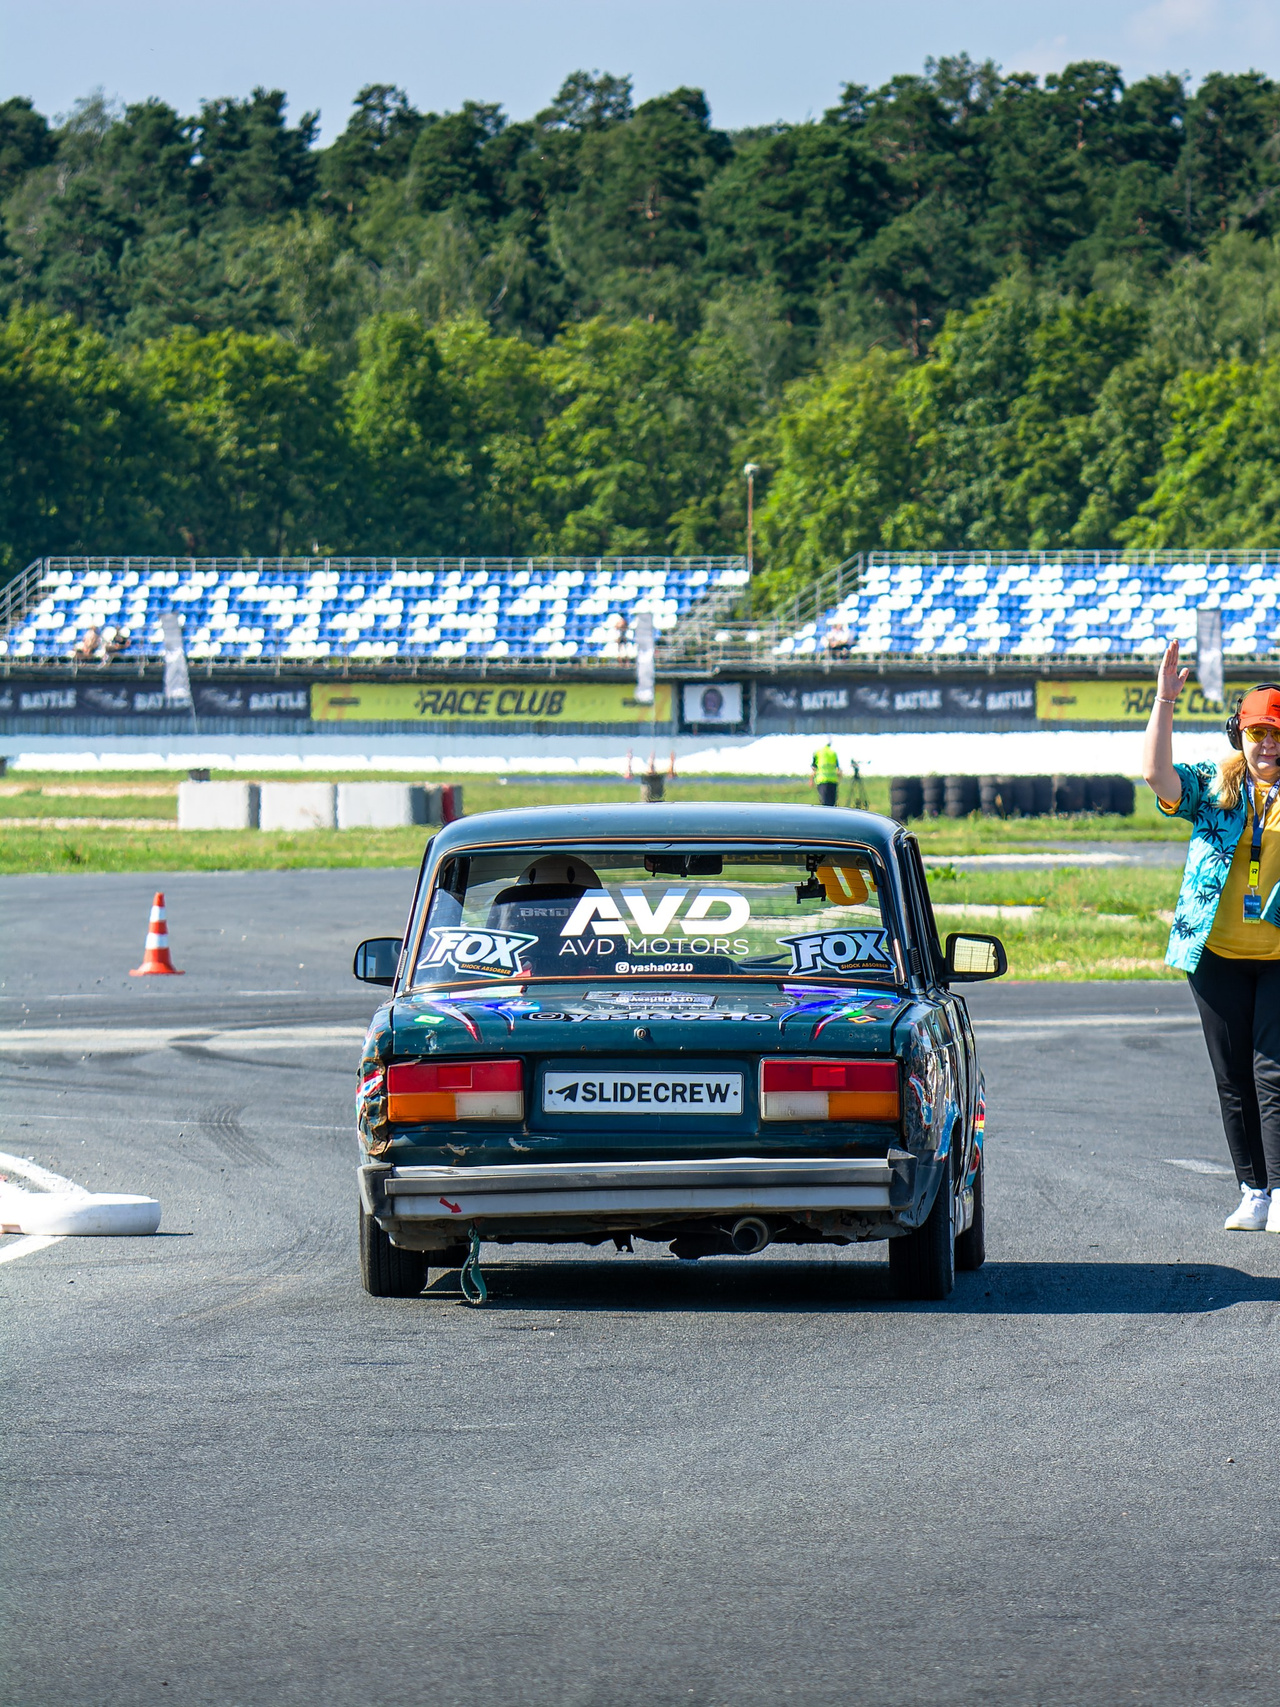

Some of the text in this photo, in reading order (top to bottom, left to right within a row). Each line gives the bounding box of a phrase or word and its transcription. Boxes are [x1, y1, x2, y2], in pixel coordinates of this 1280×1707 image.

[20, 688, 78, 710] BATTLE
[248, 690, 308, 711] BATTLE
[415, 689, 567, 716] RACE CLUB
[801, 688, 849, 711] BATTLE
[894, 689, 942, 711] BATTLE
[985, 689, 1033, 711] BATTLE
[1125, 686, 1186, 714] RAE
[519, 907, 573, 917] BRID
[559, 888, 750, 936] AVD
[429, 932, 528, 968] FOX
[558, 937, 750, 956] AVD MOTORS
[793, 932, 887, 970] FOX
[460, 962, 512, 976] SHOCK ABSORBER
[630, 961, 694, 974] yasha0210
[581, 1081, 730, 1103] SLIDECREW
